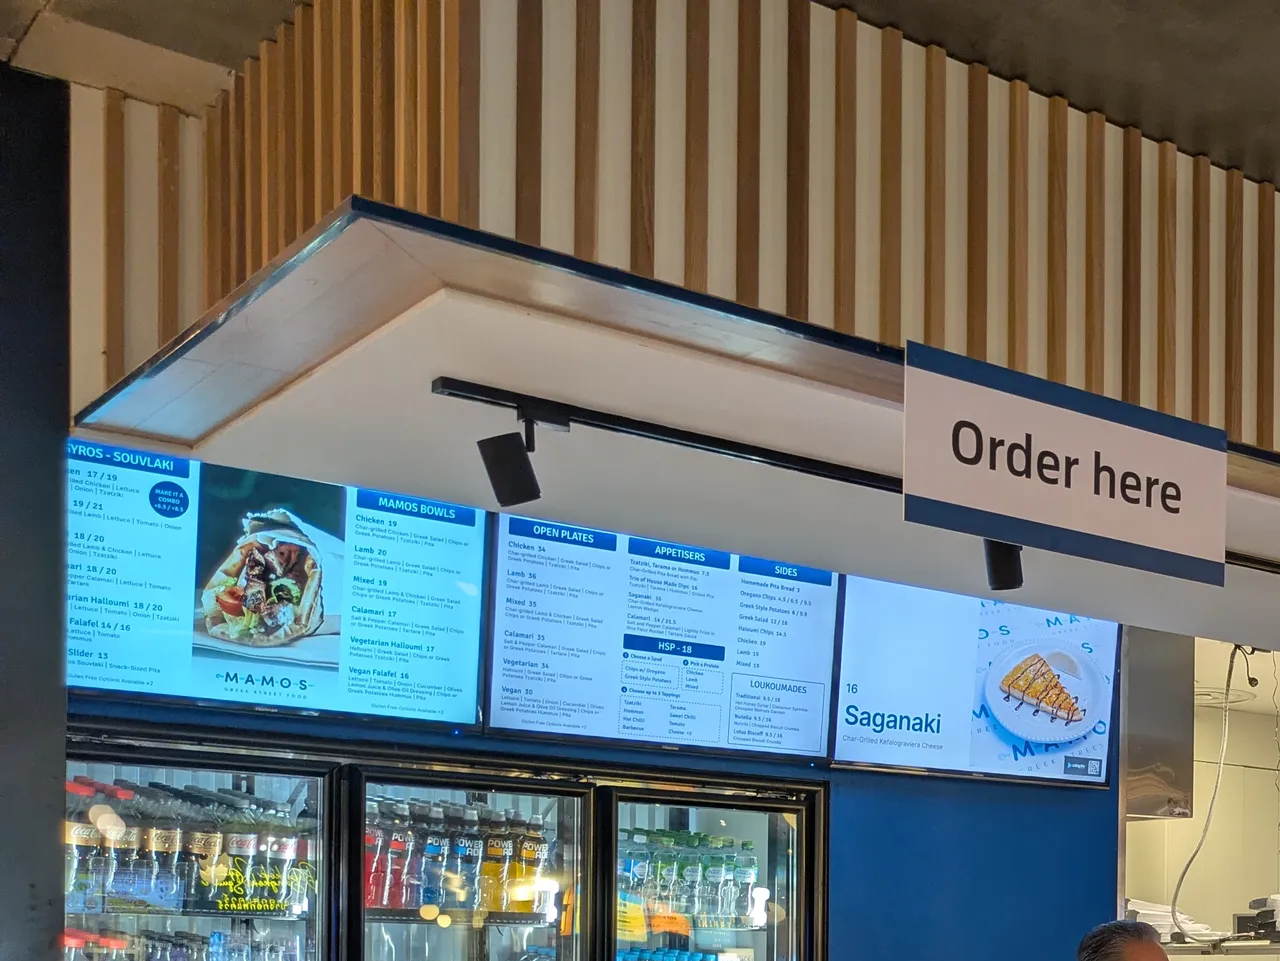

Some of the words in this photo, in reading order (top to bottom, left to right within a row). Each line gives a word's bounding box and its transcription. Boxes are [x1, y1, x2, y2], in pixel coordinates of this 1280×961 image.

[113, 452, 173, 471] SOUVLAKI
[952, 421, 1079, 489] Order
[1094, 451, 1181, 514] here
[378, 497, 418, 512] MAMOS
[421, 505, 455, 519] BOWLS
[356, 515, 384, 525] Chicken
[533, 525, 559, 538] OPEN
[561, 530, 594, 543] PLATES
[355, 545, 374, 554] Lamb
[509, 541, 534, 551] Chicken
[655, 546, 705, 562] APPETISERS
[507, 569, 525, 578] Lamb
[775, 566, 798, 577] SIDES
[353, 576, 374, 585] Mixed
[741, 579, 768, 589] Homemade
[770, 583, 781, 591] Pita
[782, 585, 795, 593] Bread
[91, 596, 129, 607] Halloumi
[506, 597, 525, 606] Mixed
[740, 602, 753, 611] Greek
[352, 606, 384, 616] Calamari
[627, 613, 650, 621] Calamari
[739, 614, 753, 623] Greek
[754, 616, 768, 624] Salad
[70, 618, 98, 627] Falafel
[504, 630, 533, 639] Calamari
[761, 628, 774, 636] Chips
[351, 636, 389, 647] Vegetarian
[391, 640, 423, 651] Halloumi
[738, 637, 757, 646] Chicken
[658, 641, 675, 651] HSP
[682, 645, 692, 654] 18
[69, 649, 93, 658] Slider
[503, 658, 538, 669] Vegetarian
[349, 666, 370, 676] Vegan
[373, 669, 396, 678] Falafel
[502, 686, 521, 695] Vegan
[750, 680, 807, 694] LOUKOUMADES
[846, 683, 857, 693] 16
[845, 704, 941, 735] Saganaki
[843, 735, 877, 744] Char-Grilled
[879, 738, 920, 749] Kefalograviera
[921, 742, 943, 750] Cheese
